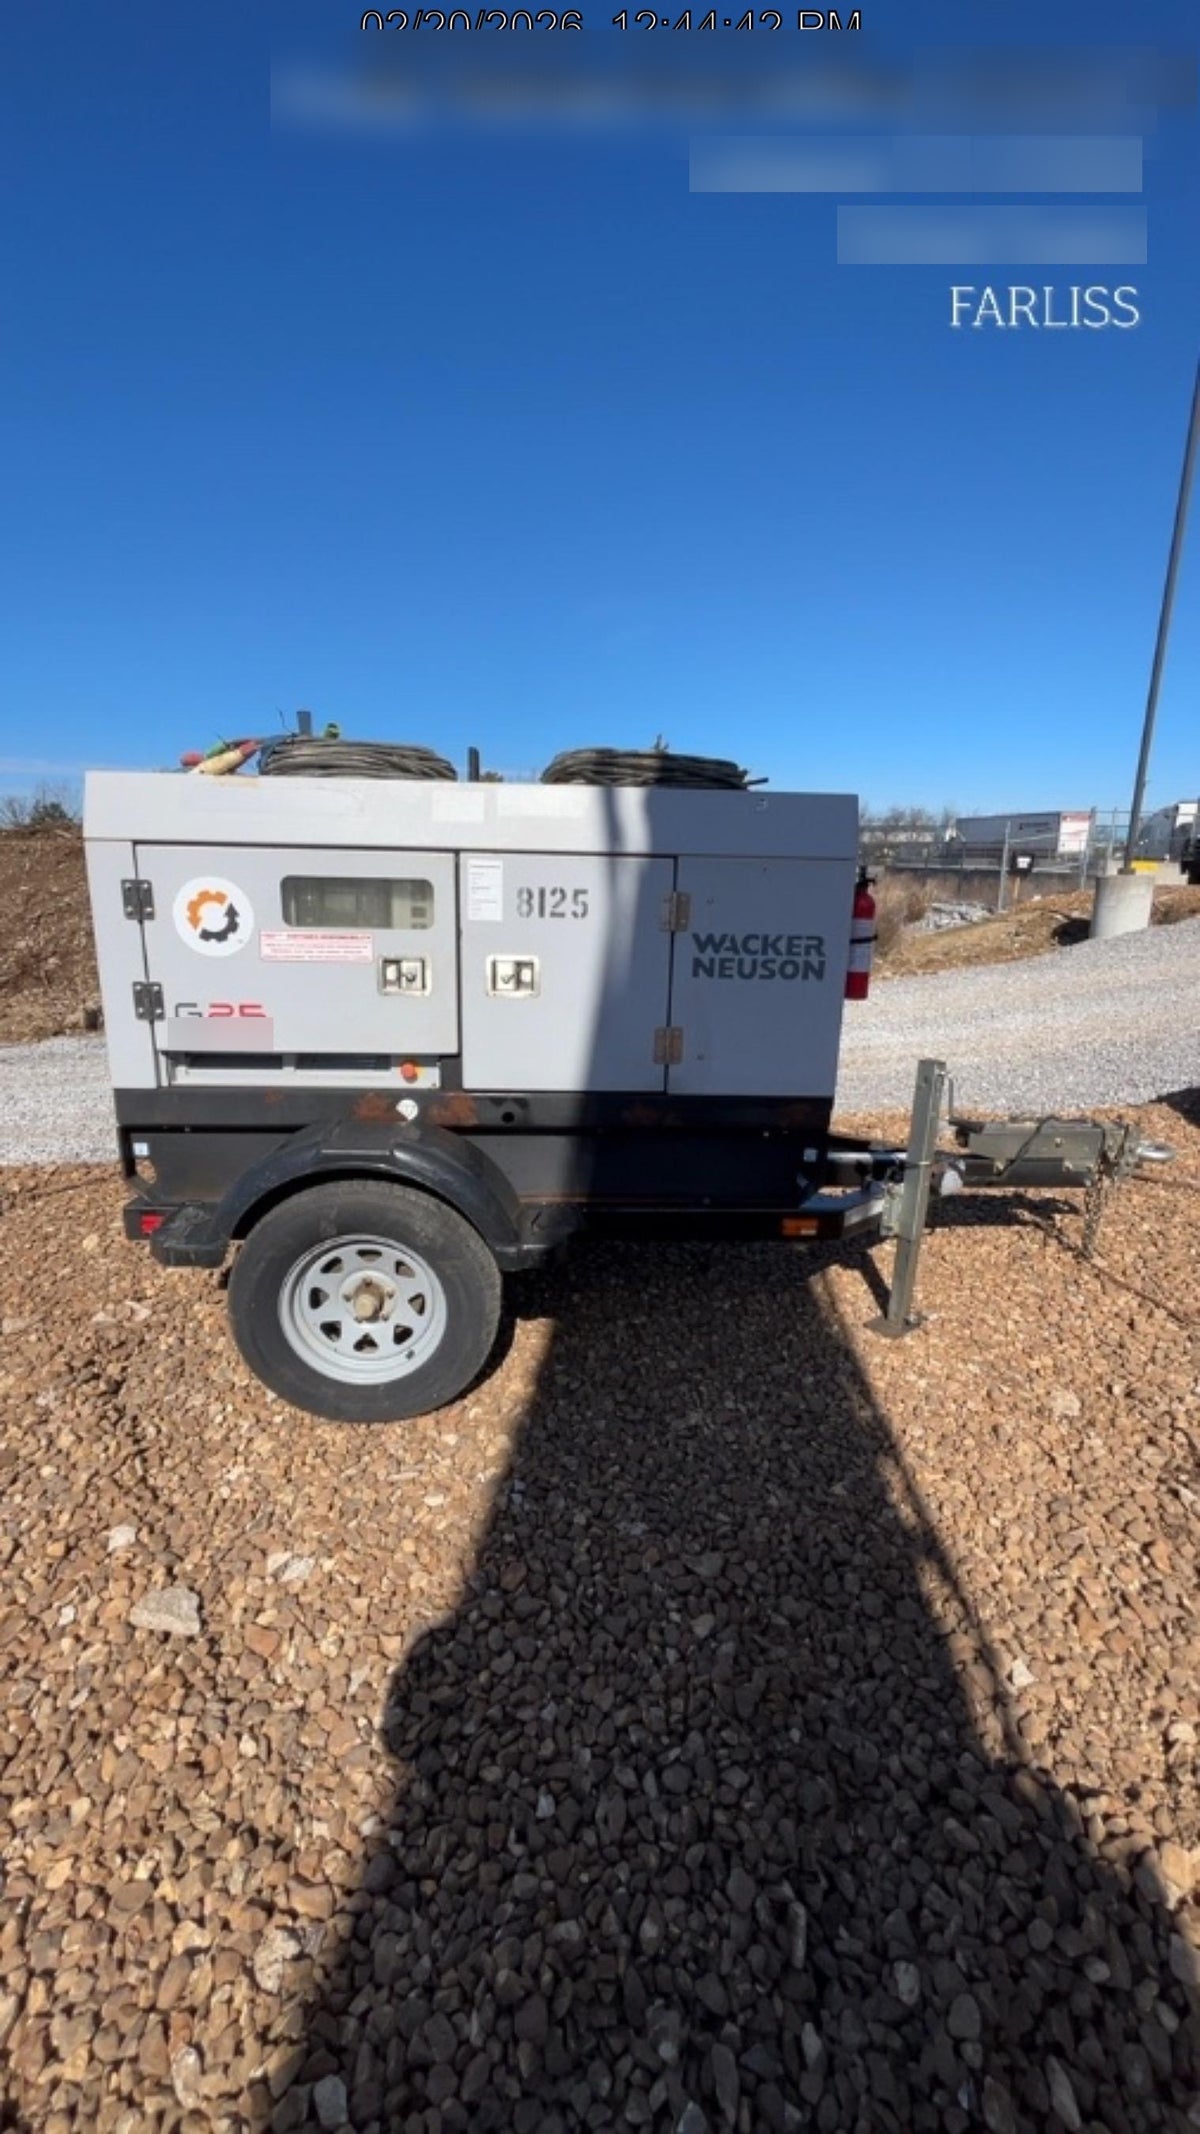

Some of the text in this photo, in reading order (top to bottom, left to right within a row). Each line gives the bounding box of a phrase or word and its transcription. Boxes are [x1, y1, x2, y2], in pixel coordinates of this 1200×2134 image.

[516, 886, 589, 918] 8125
[691, 932, 826, 957] WACKER
[691, 957, 826, 980] NEUSON
